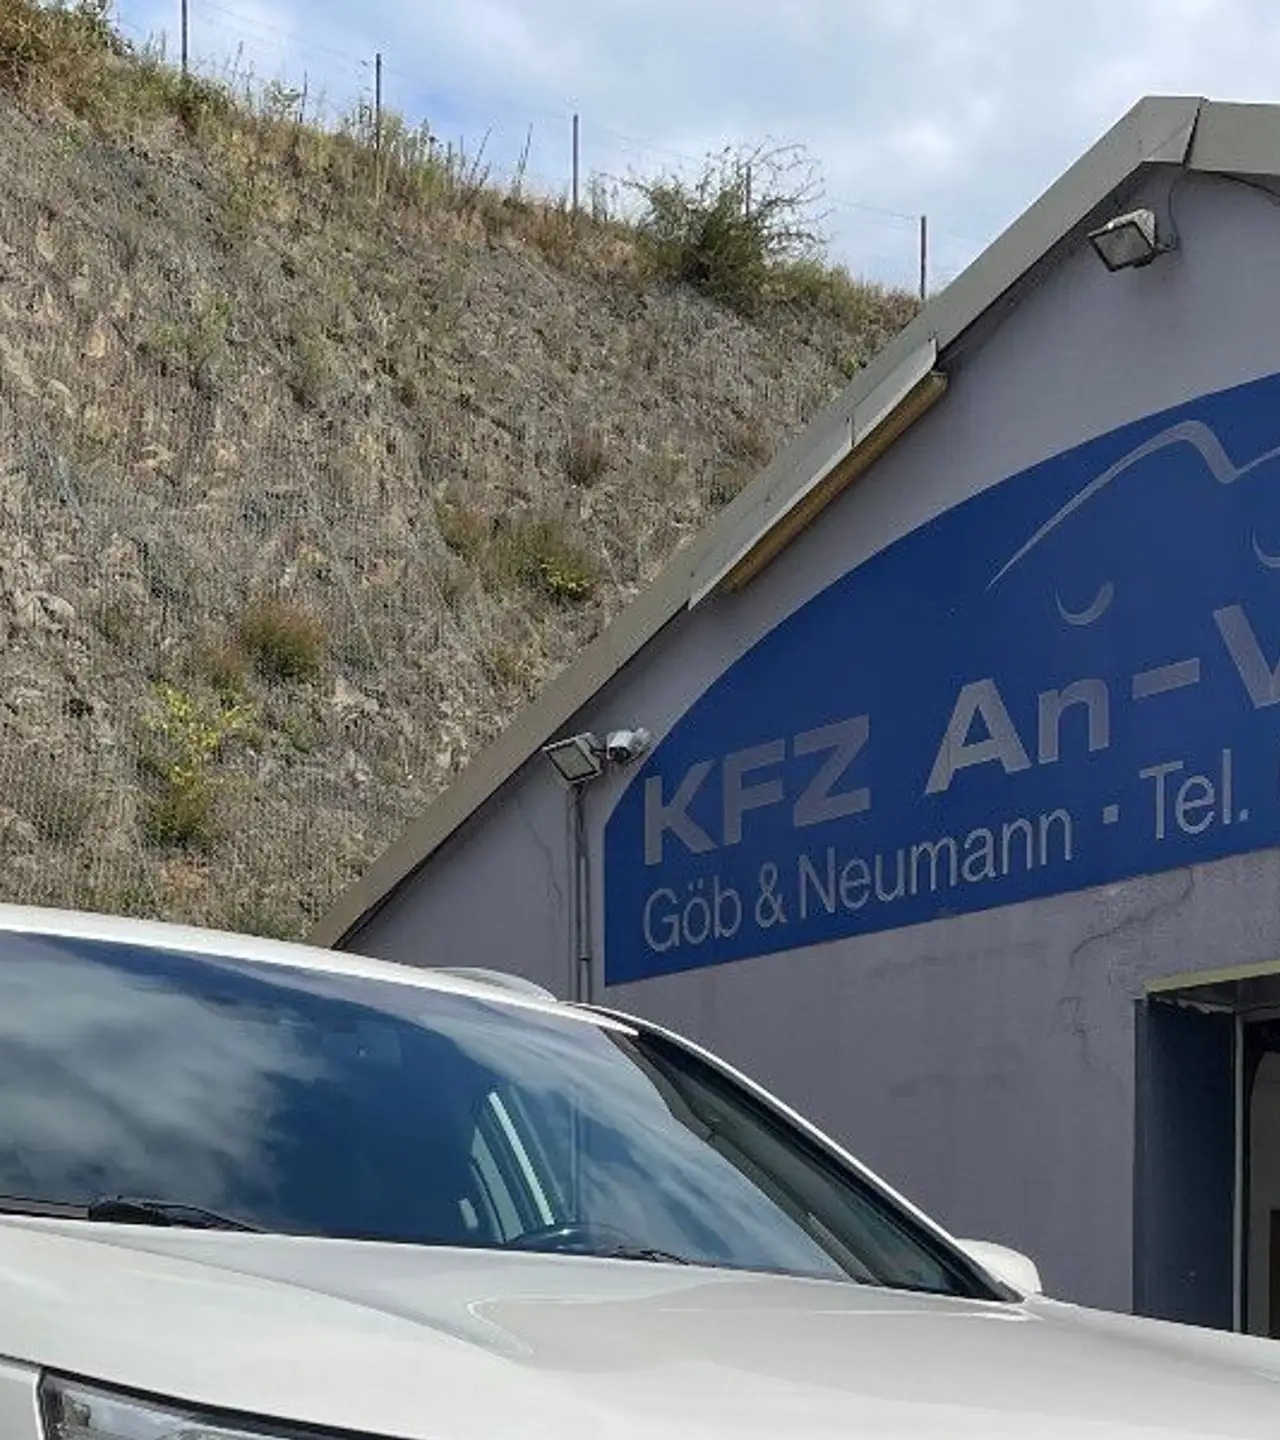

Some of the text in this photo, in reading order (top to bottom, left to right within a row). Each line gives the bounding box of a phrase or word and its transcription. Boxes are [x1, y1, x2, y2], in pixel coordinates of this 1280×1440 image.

[642, 875, 743, 954] Göb
[754, 861, 789, 929] &
[798, 807, 1074, 921] Neumann
[1138, 747, 1250, 841] Tel.
[643, 713, 871, 867] KFZ
